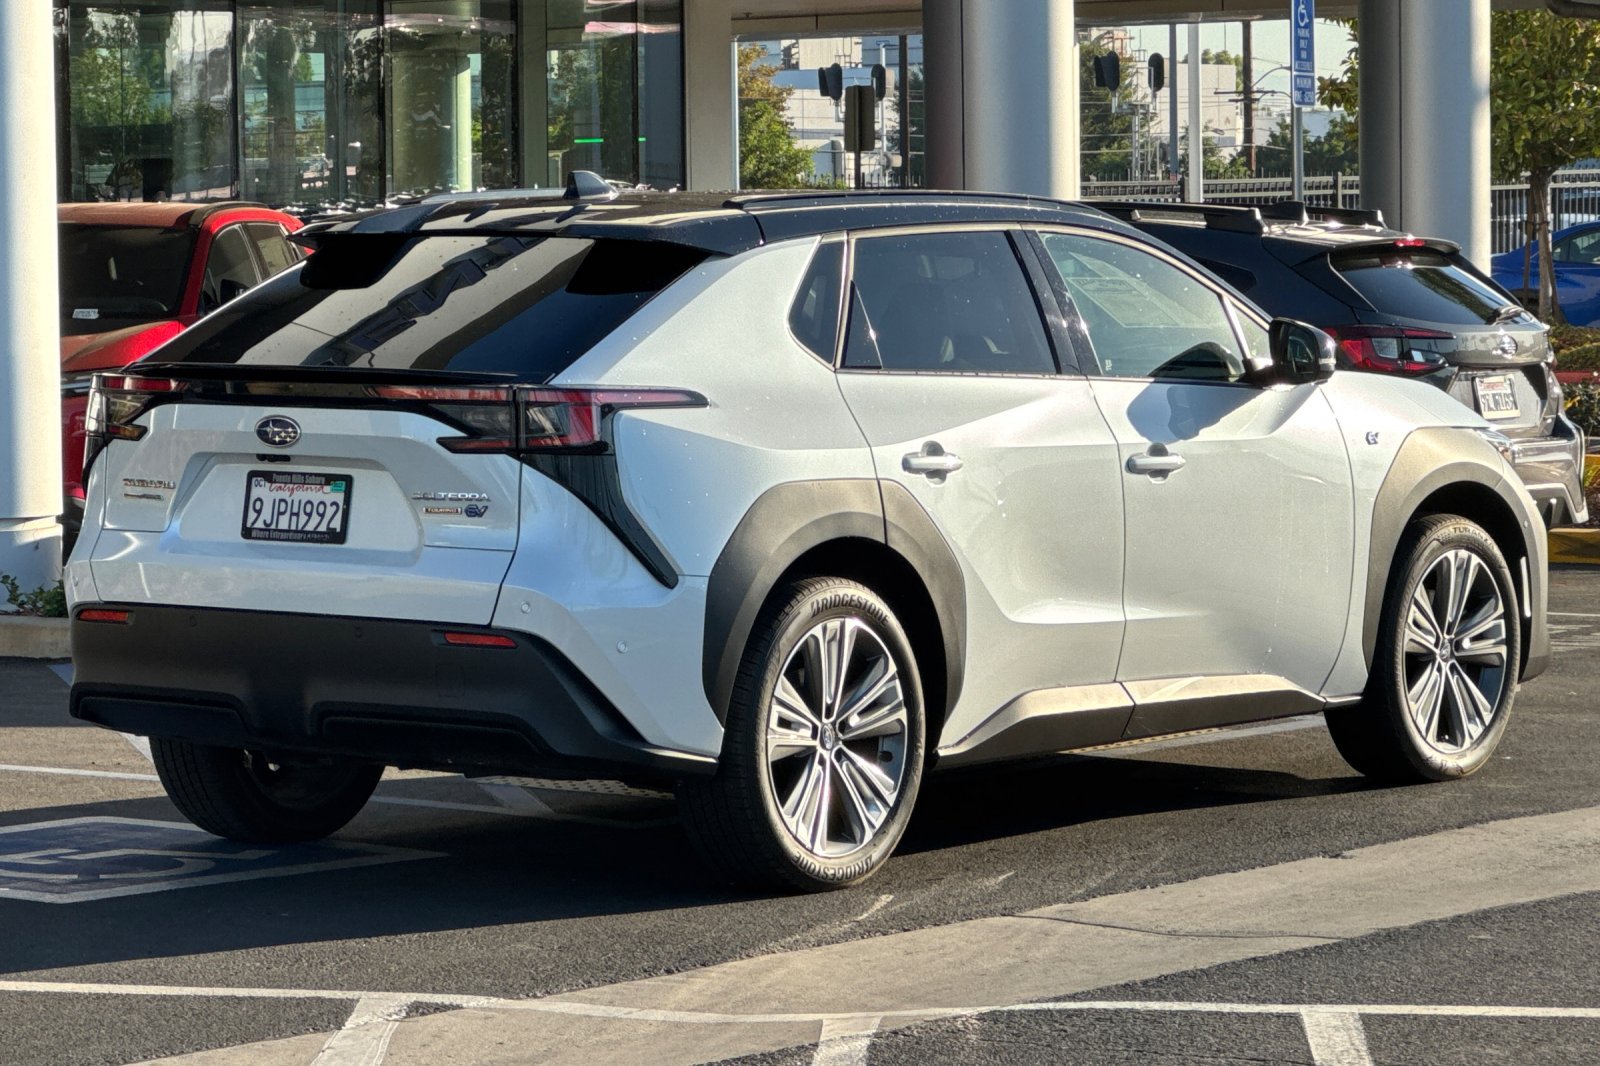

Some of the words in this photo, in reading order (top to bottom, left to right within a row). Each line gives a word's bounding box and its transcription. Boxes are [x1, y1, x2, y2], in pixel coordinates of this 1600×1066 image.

[268, 483, 332, 497] California
[250, 496, 340, 533] 9JPH992
[810, 593, 889, 626] BRIDGESTONE
[791, 851, 875, 881] BRIDGESTONE
